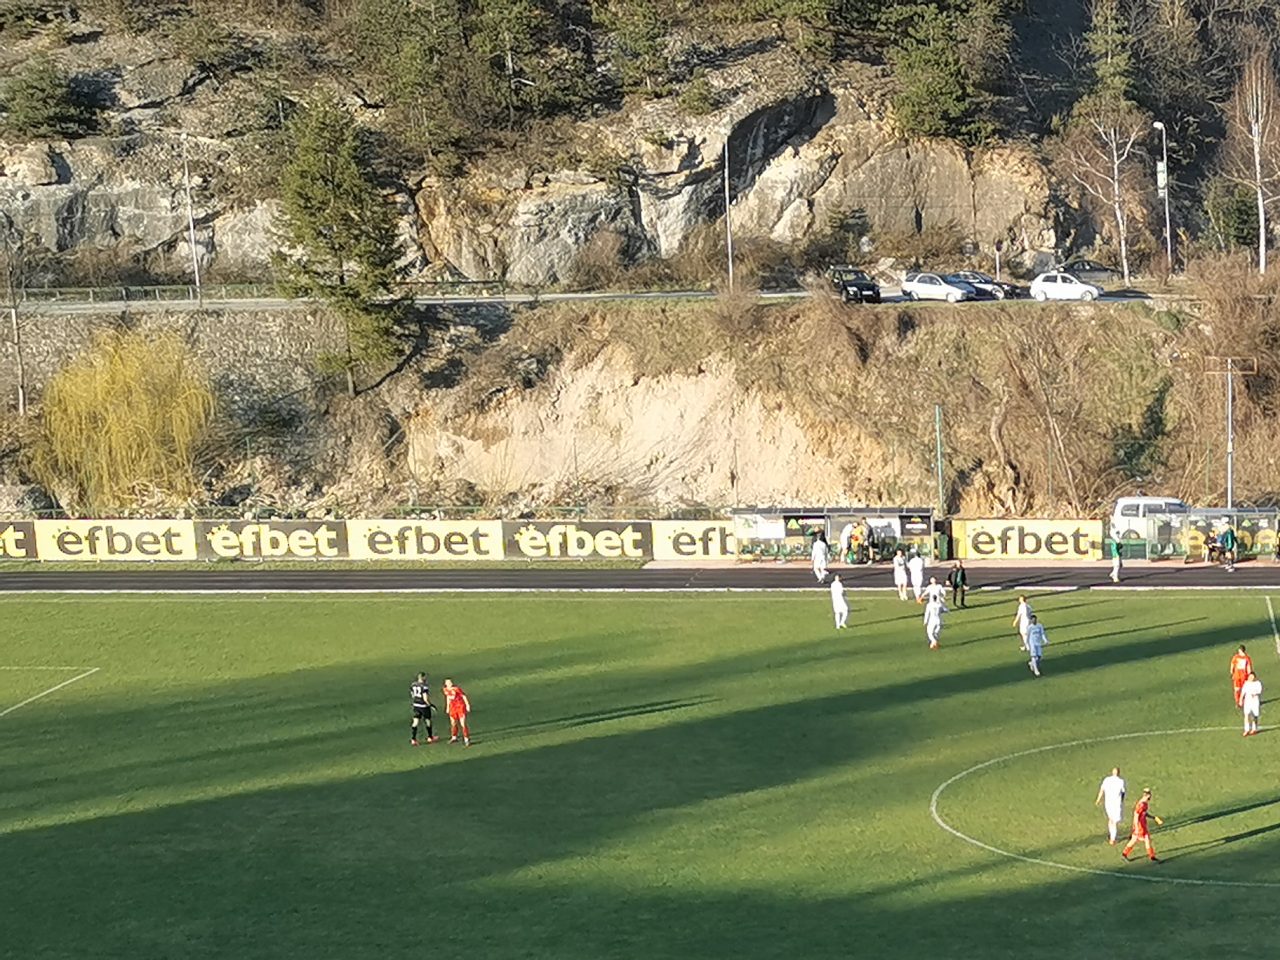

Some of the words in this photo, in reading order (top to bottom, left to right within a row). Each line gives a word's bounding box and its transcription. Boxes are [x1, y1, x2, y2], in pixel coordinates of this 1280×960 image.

[57, 526, 183, 555] efbet
[211, 524, 338, 557] efbet
[367, 526, 489, 555] efbet
[518, 524, 643, 557] efbet
[972, 526, 1089, 555] efbet
